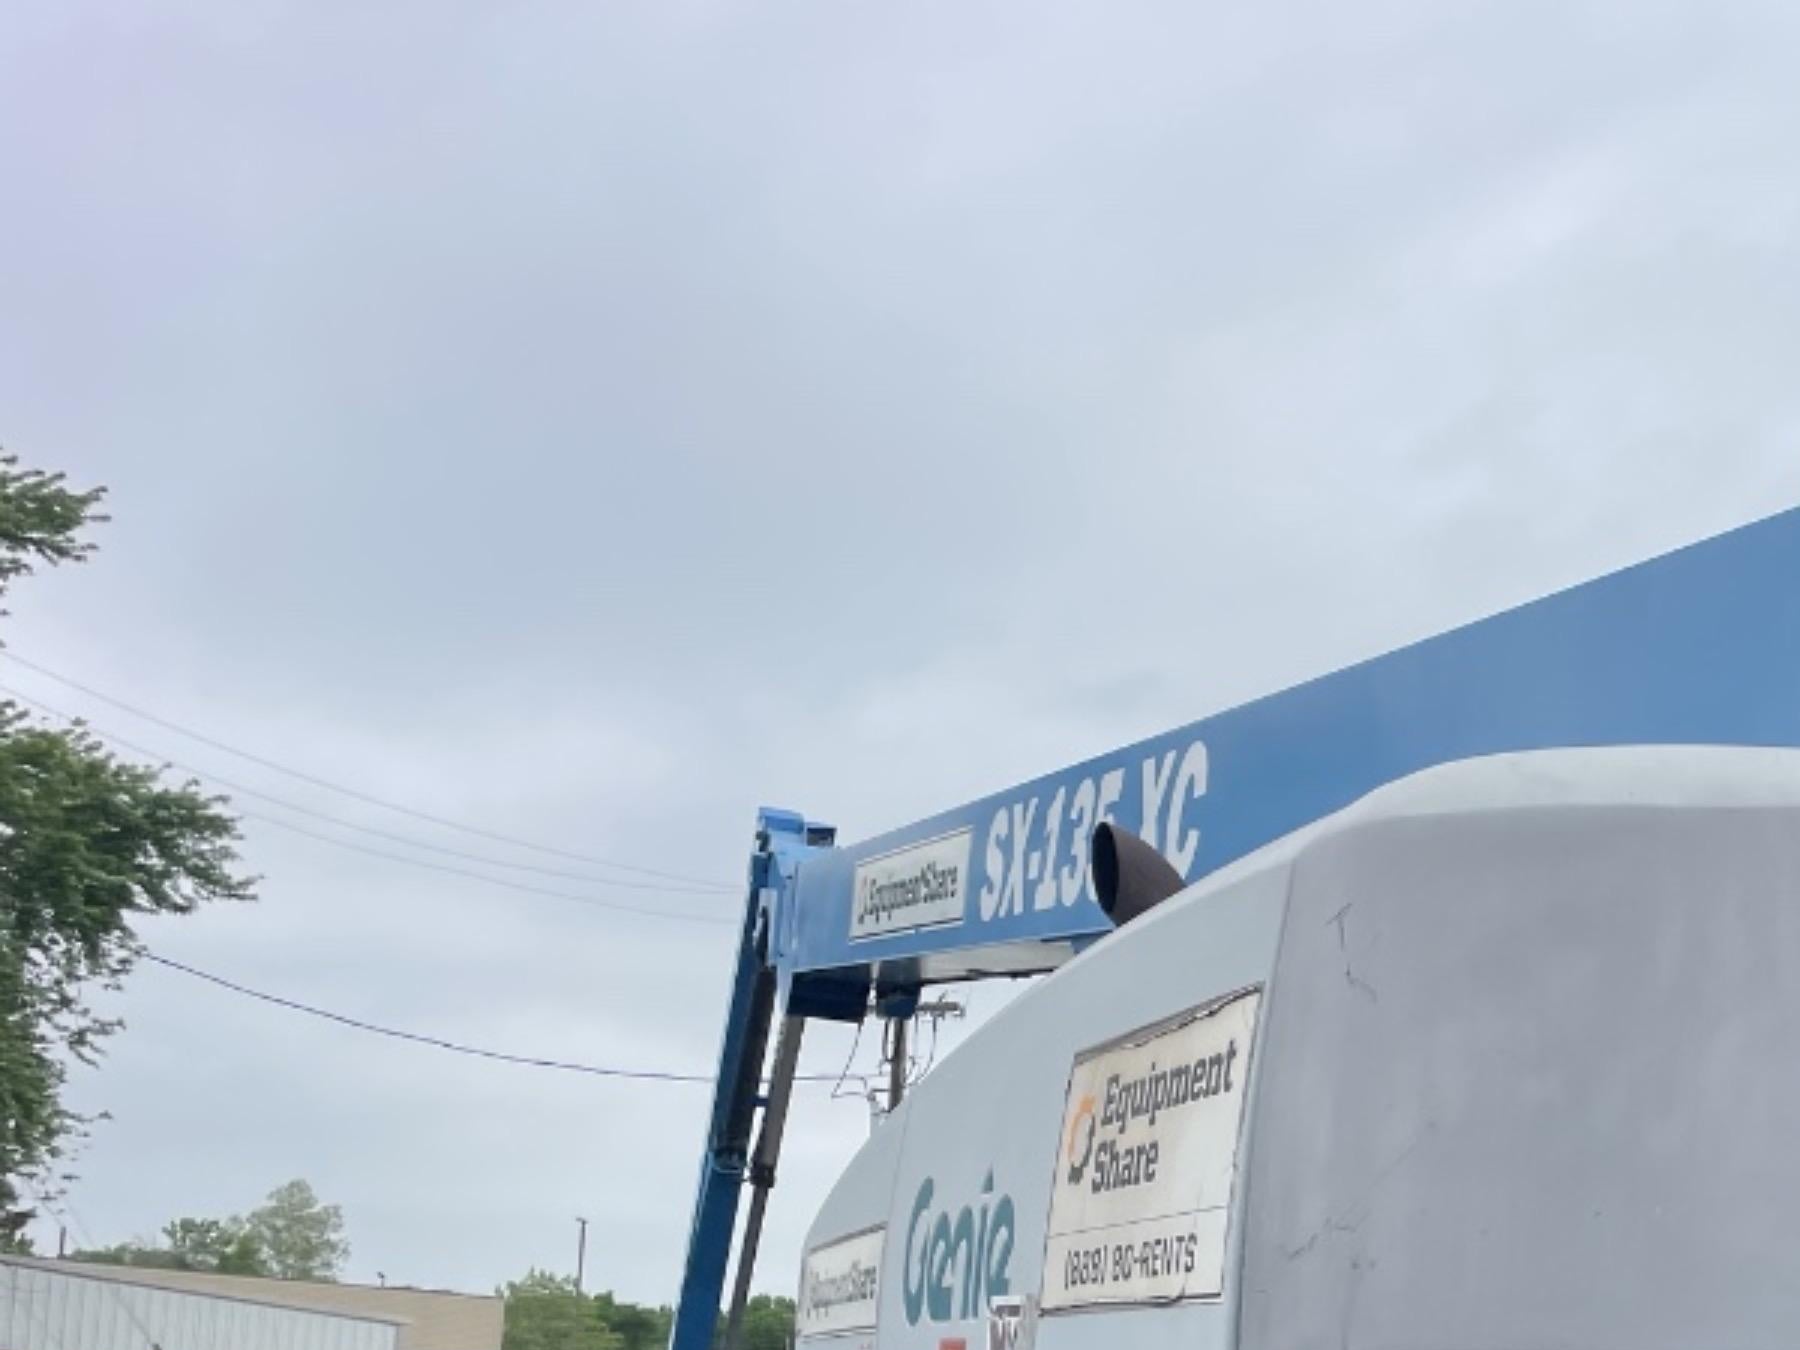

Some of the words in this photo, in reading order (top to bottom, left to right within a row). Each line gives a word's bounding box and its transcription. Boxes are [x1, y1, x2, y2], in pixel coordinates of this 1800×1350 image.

[1101, 1038, 1237, 1134] Equipment
[1092, 1139, 1159, 1194] Share
[903, 1162, 1015, 1327] Genie
